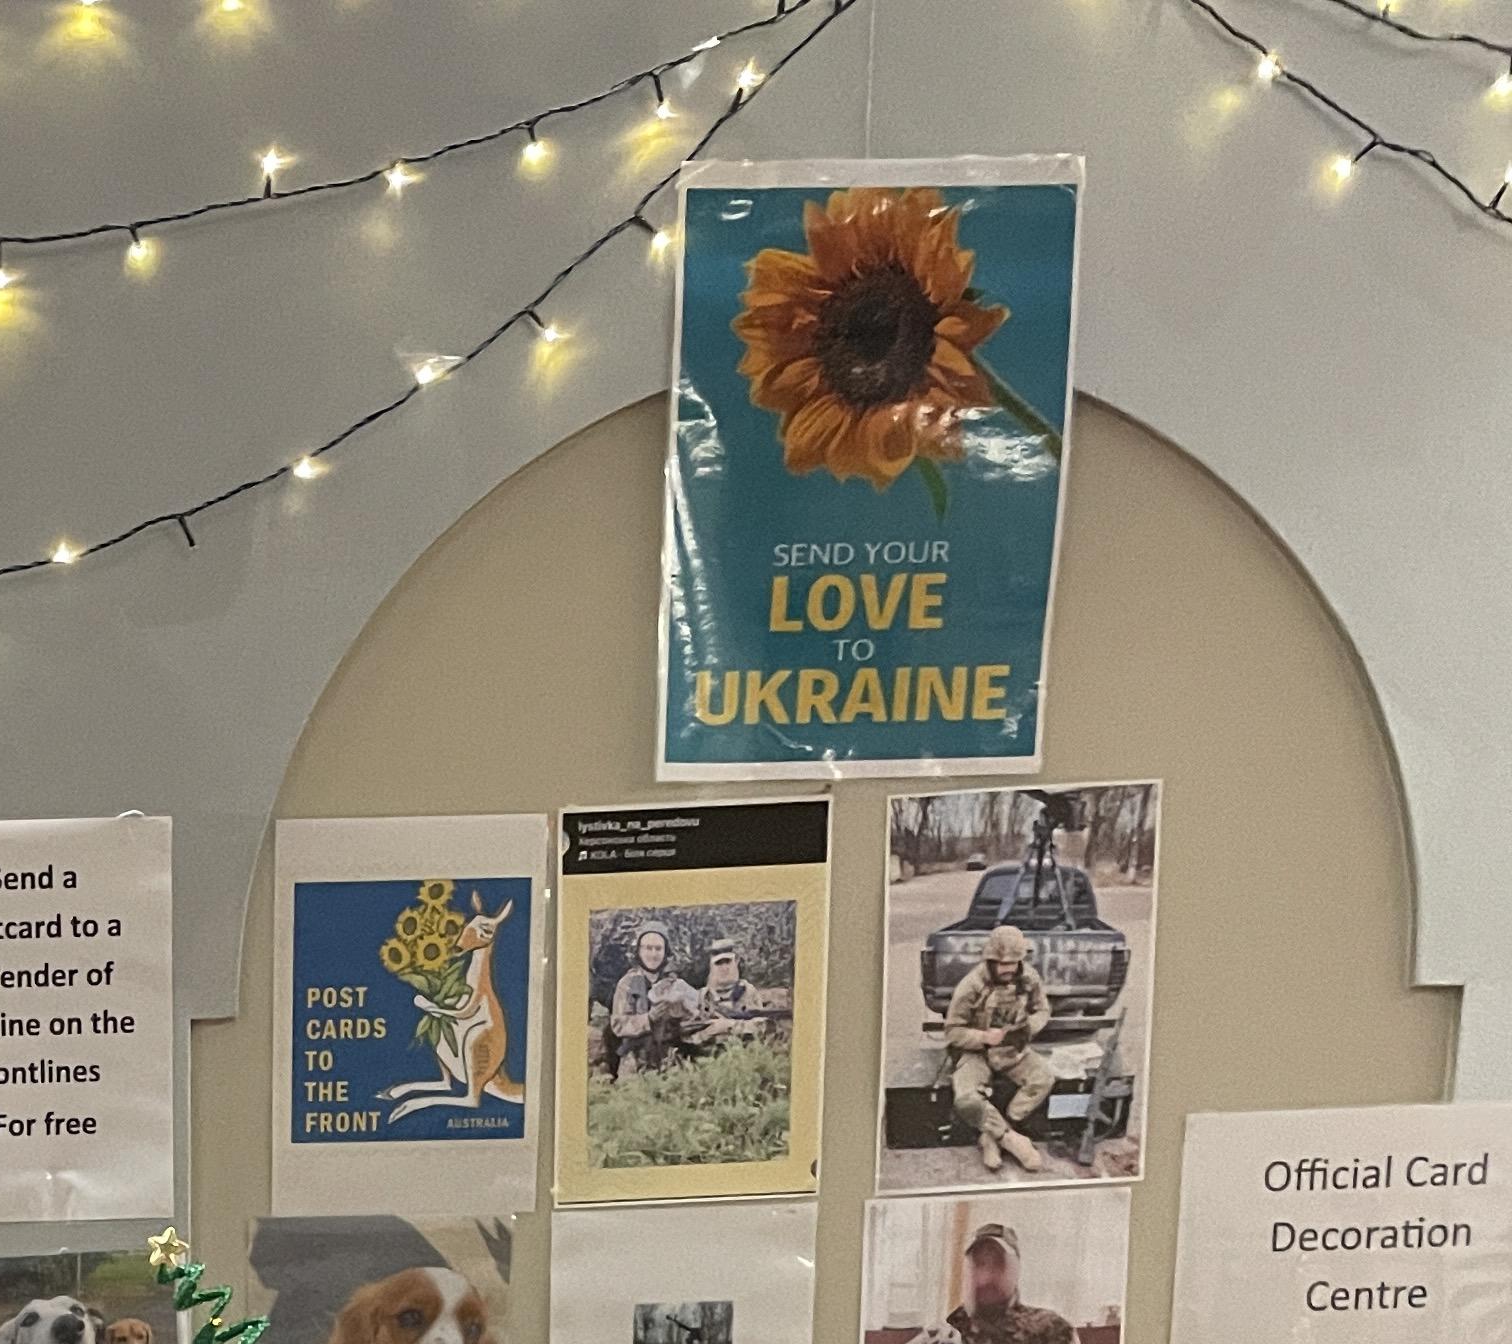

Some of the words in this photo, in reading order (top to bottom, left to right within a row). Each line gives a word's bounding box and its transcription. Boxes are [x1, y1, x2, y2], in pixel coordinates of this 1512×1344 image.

[773, 544, 855, 567] SEND
[865, 540, 950, 566] YOUR
[769, 572, 947, 633] LOVE
[833, 638, 875, 662] TO
[694, 664, 1011, 726] UKRAINE
[63, 869, 77, 889] a
[72, 917, 100, 939] to
[107, 919, 122, 938] a
[86, 961, 115, 988] of
[306, 986, 368, 1008] POST
[50, 1017, 82, 1037] on
[91, 1011, 136, 1035] the
[306, 1017, 387, 1040] CARDS
[304, 1050, 334, 1072] TO
[304, 1081, 349, 1103] THE
[43, 1112, 98, 1137] free
[304, 1111, 381, 1134] FRONT
[446, 1117, 510, 1130] AUSTRALIA
[1263, 1156, 1392, 1193] Official
[1405, 1153, 1489, 1188] Card
[1270, 1217, 1472, 1253] Decoration
[1304, 1280, 1428, 1312] Centre
